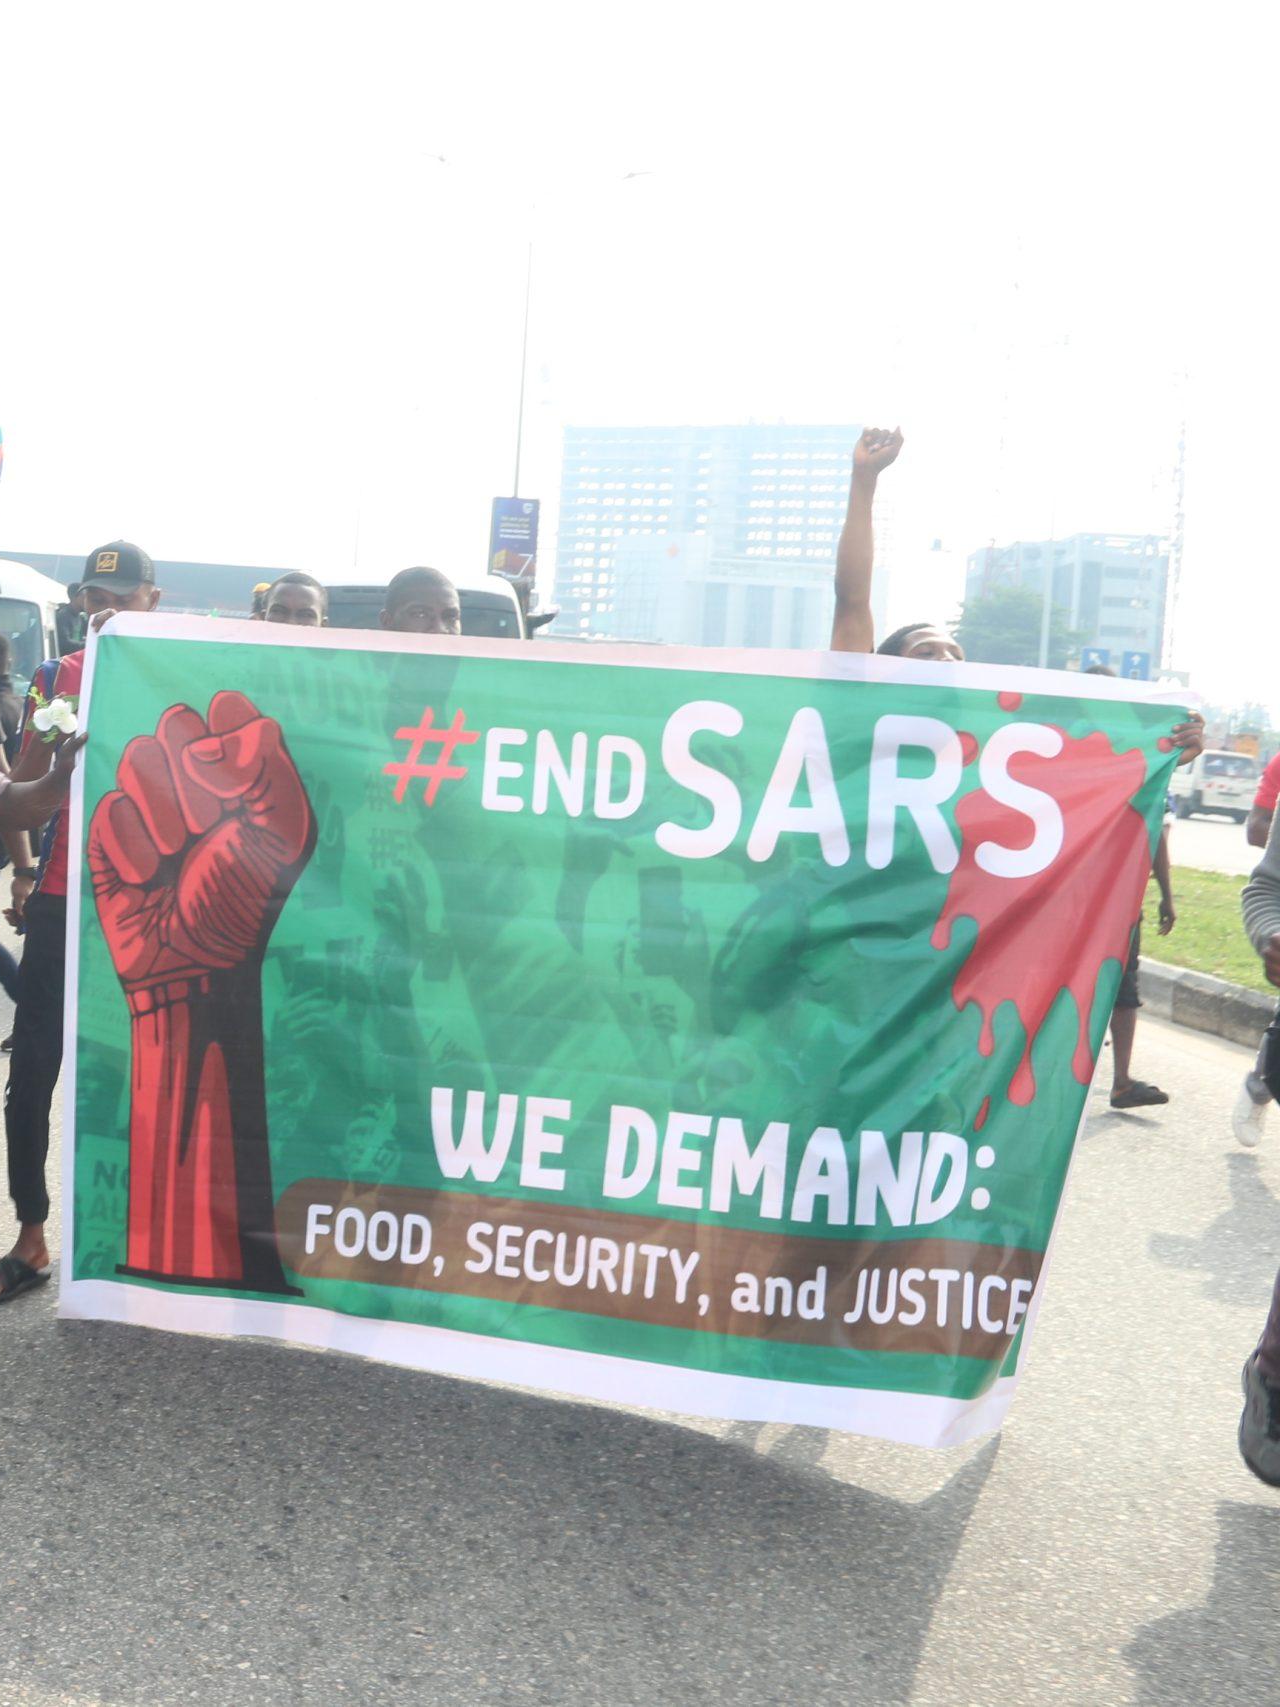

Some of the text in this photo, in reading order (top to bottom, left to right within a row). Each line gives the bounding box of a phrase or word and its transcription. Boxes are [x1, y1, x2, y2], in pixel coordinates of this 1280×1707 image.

[431, 1086, 996, 1227] WE DEMAND:
[304, 1203, 1033, 1335] FOOD, SECURITY, and JUSTICE
